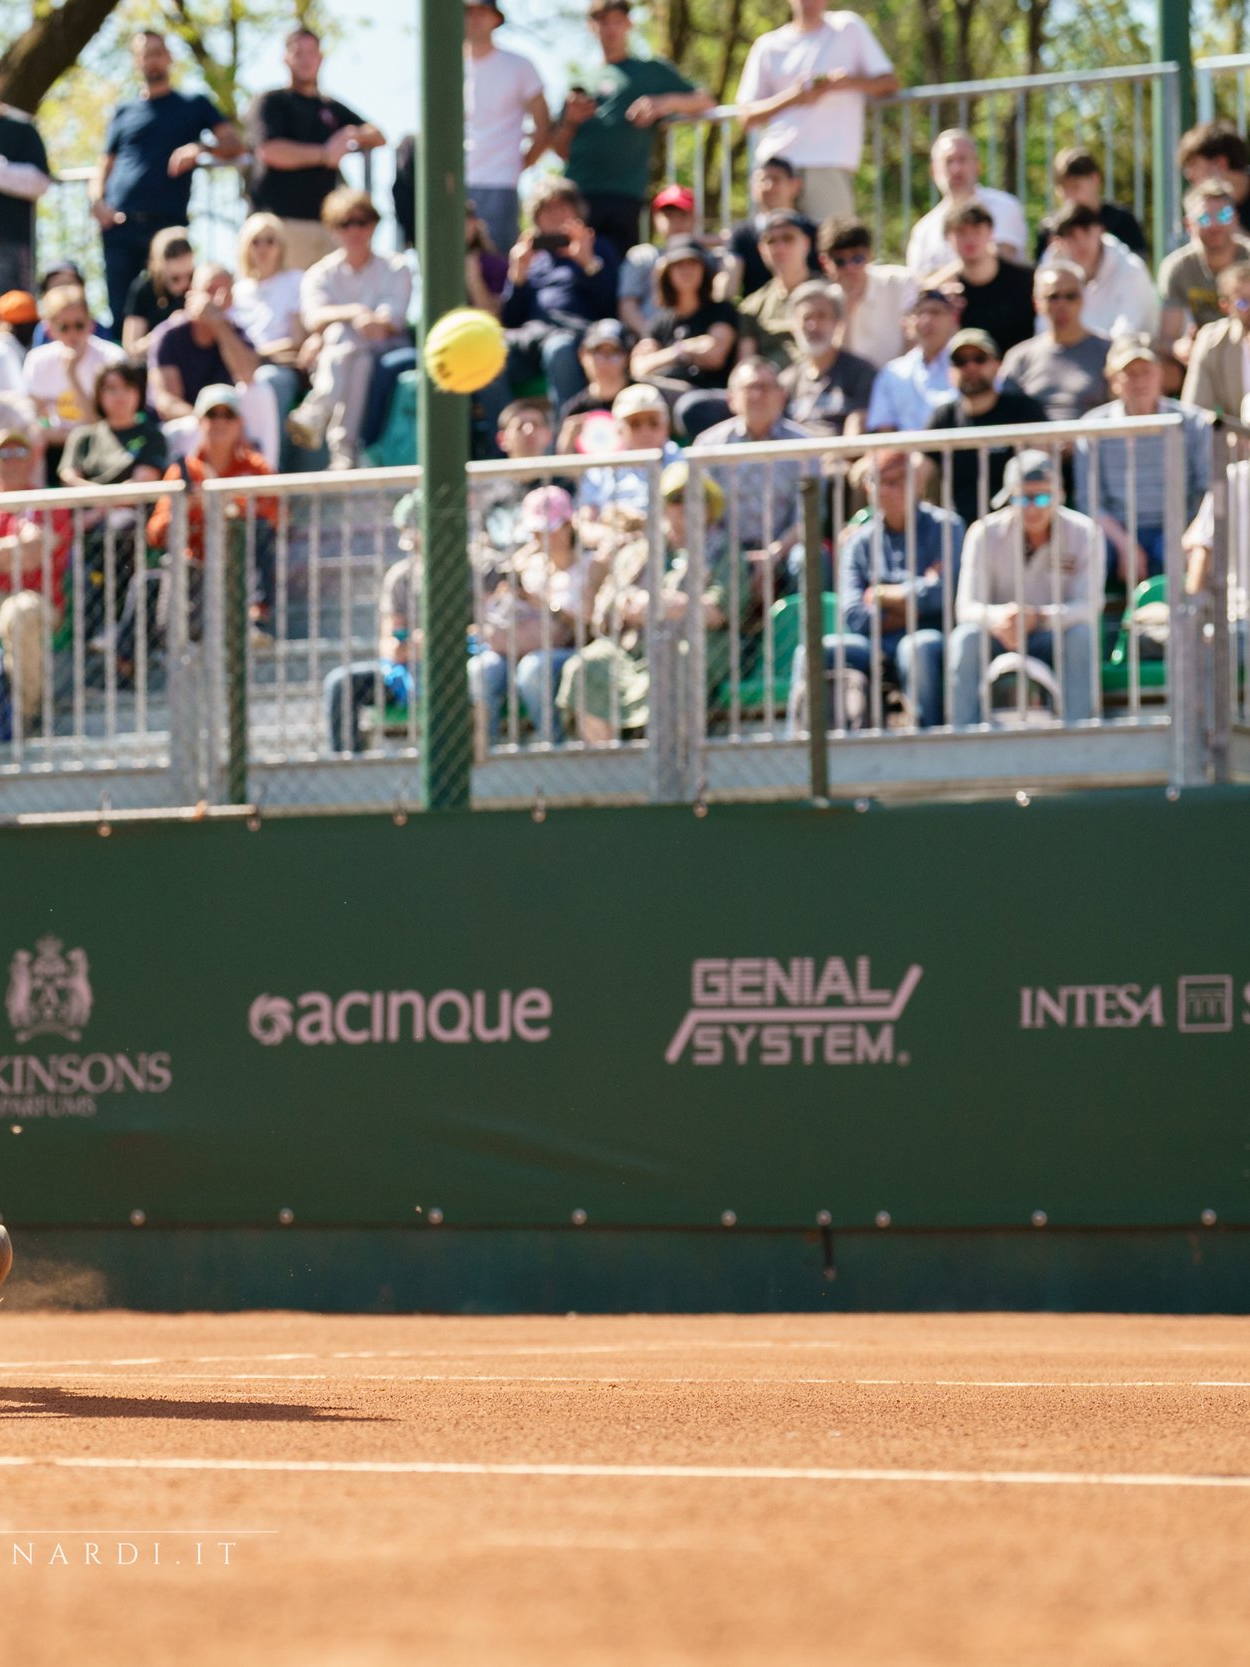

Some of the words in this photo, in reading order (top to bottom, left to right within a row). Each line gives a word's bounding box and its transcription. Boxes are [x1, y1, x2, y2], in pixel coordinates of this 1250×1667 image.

[691, 956, 892, 1006] GENIAL
[1019, 983, 1164, 1029] INTESA
[295, 987, 553, 1045] acinque
